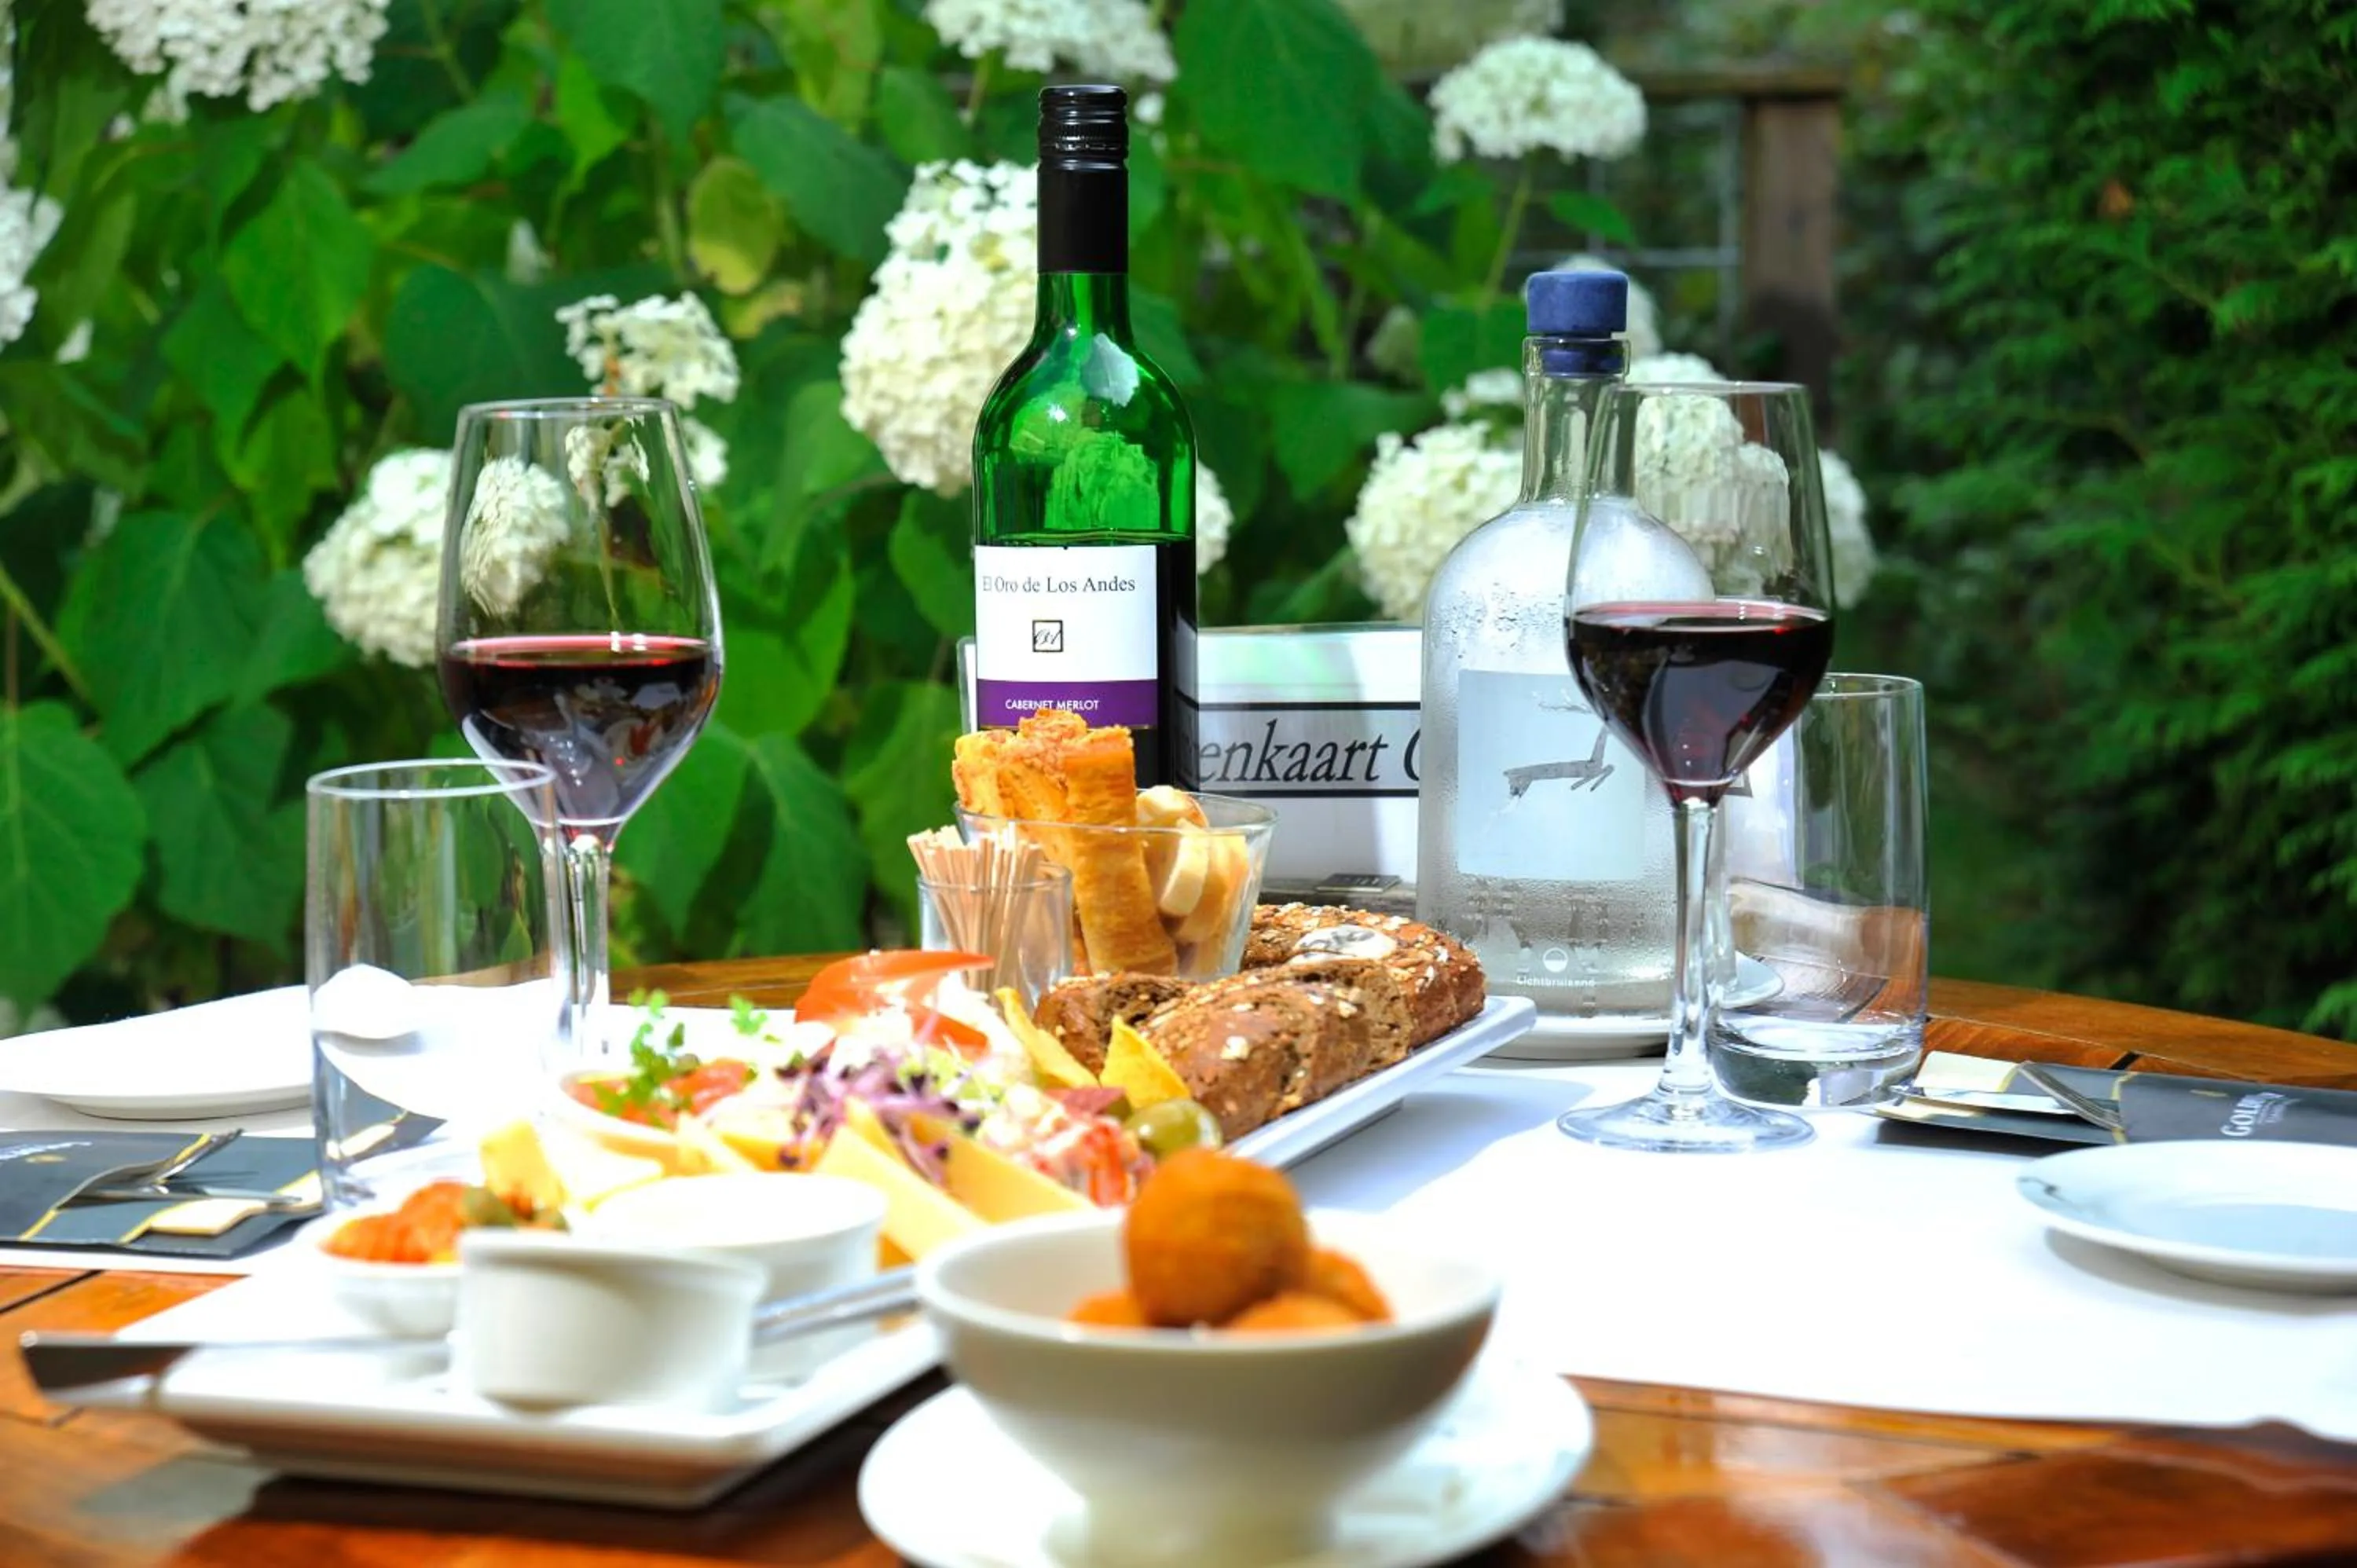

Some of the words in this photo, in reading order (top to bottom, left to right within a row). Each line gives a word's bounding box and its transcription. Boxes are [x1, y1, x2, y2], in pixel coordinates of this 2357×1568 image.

[994, 576, 1018, 592] Oro
[1023, 577, 1041, 592] de
[1047, 577, 1077, 592] Los
[1083, 575, 1136, 592] Andes
[1005, 698, 1054, 710] CABERNET
[1056, 699, 1099, 710] MERLOT
[1199, 718, 1389, 782] enkaart
